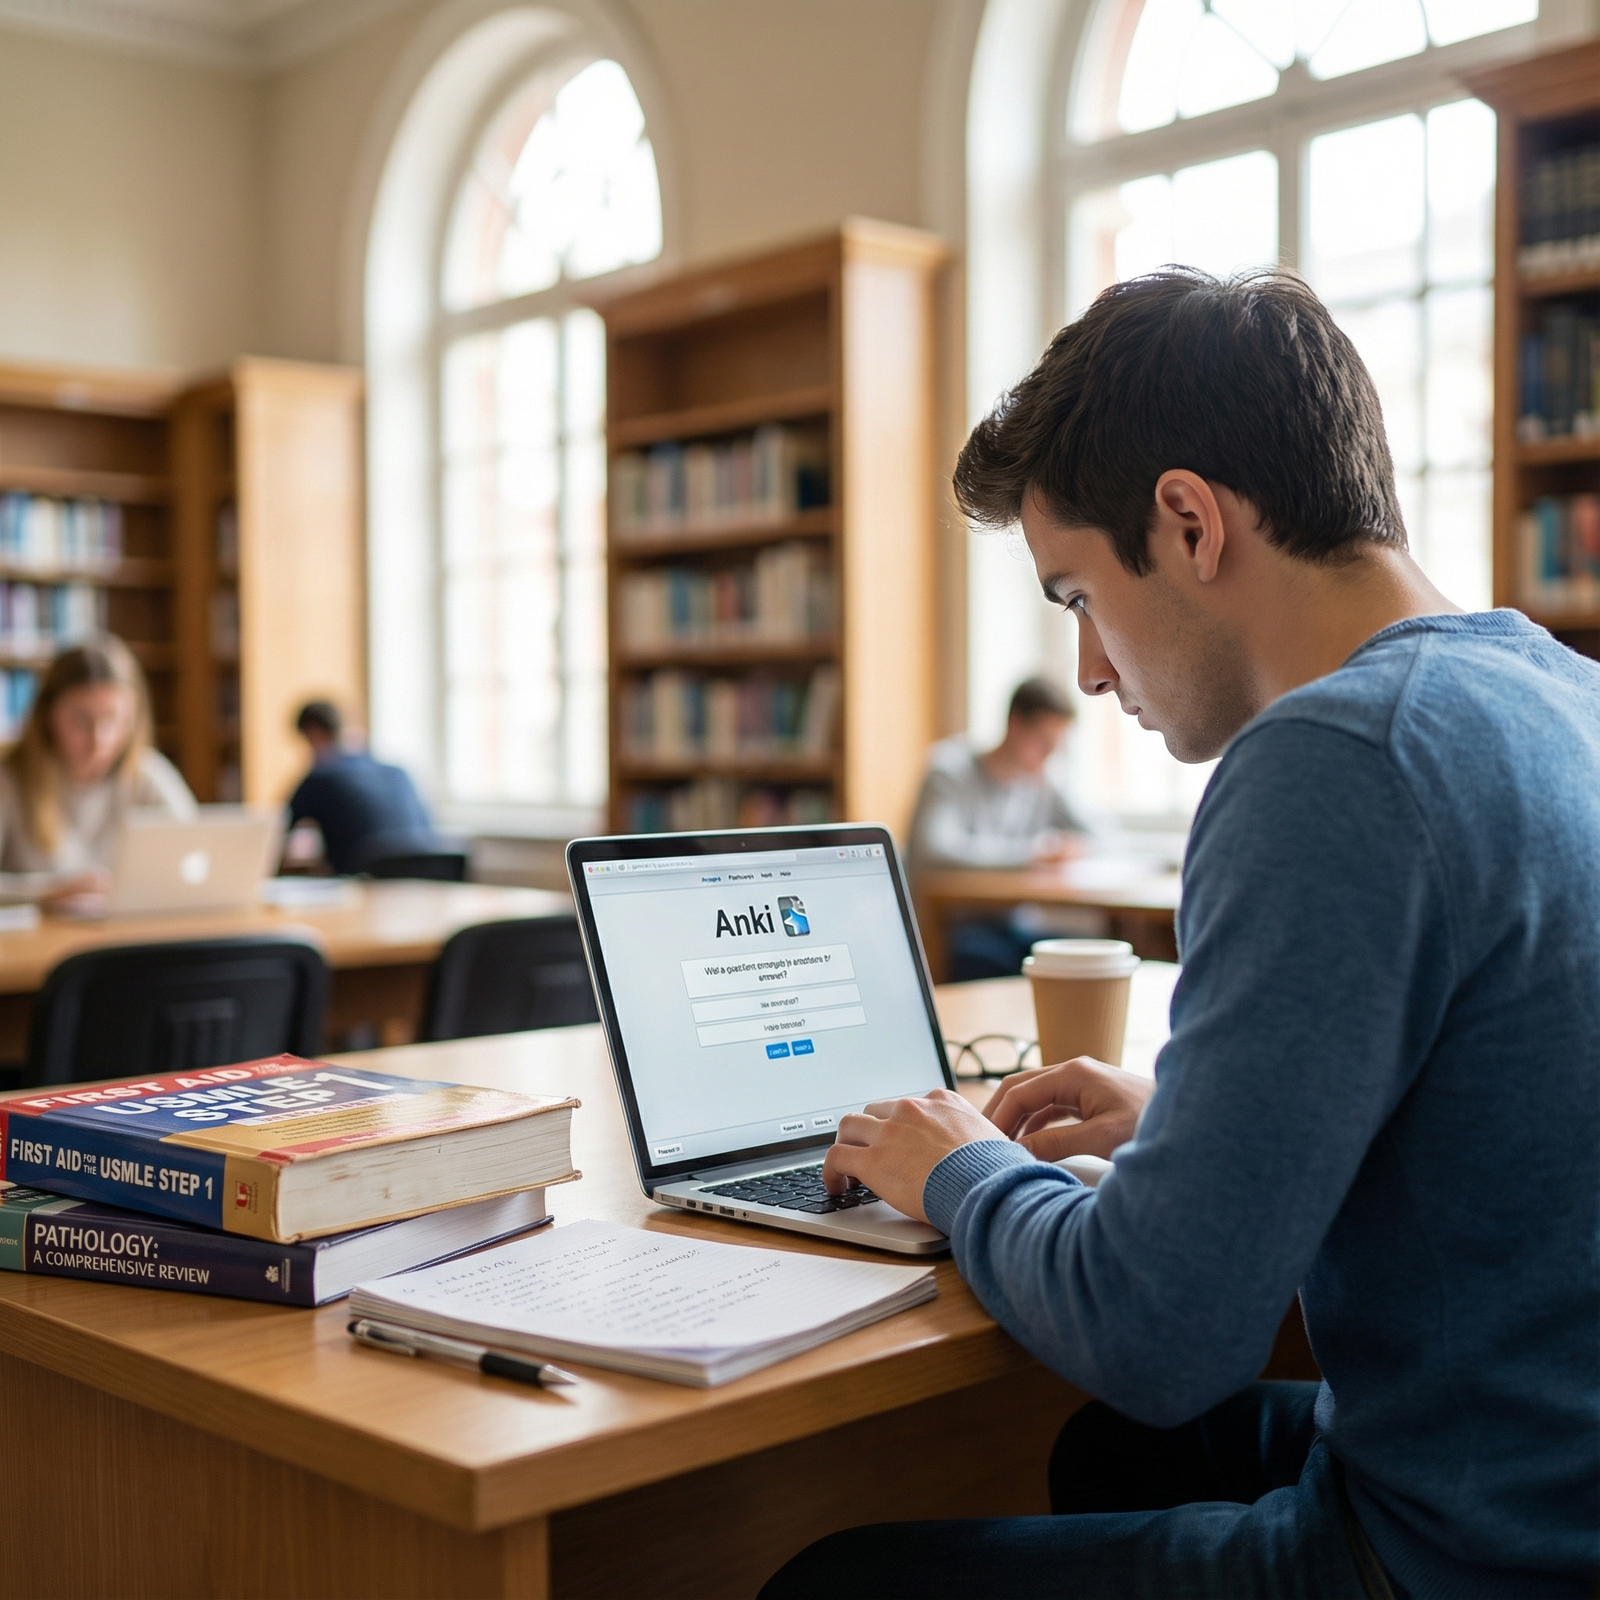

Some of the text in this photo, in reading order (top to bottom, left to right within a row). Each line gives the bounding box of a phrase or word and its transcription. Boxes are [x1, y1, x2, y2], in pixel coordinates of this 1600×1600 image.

[716, 904, 775, 938] Anki
[22, 1069, 253, 1108] FIRST AID
[93, 1076, 322, 1115] USMLE
[173, 1089, 337, 1122] STEP
[313, 1071, 395, 1091] 1
[10, 1138, 53, 1166] FIRST
[55, 1147, 82, 1172] AID
[100, 1156, 154, 1188] USMLE
[158, 1167, 201, 1197] STEP
[204, 1176, 213, 1200] 1
[33, 1223, 159, 1260] PATHOLOGY:
[33, 1250, 210, 1285] A COMPREHENSIVE REVIEW
